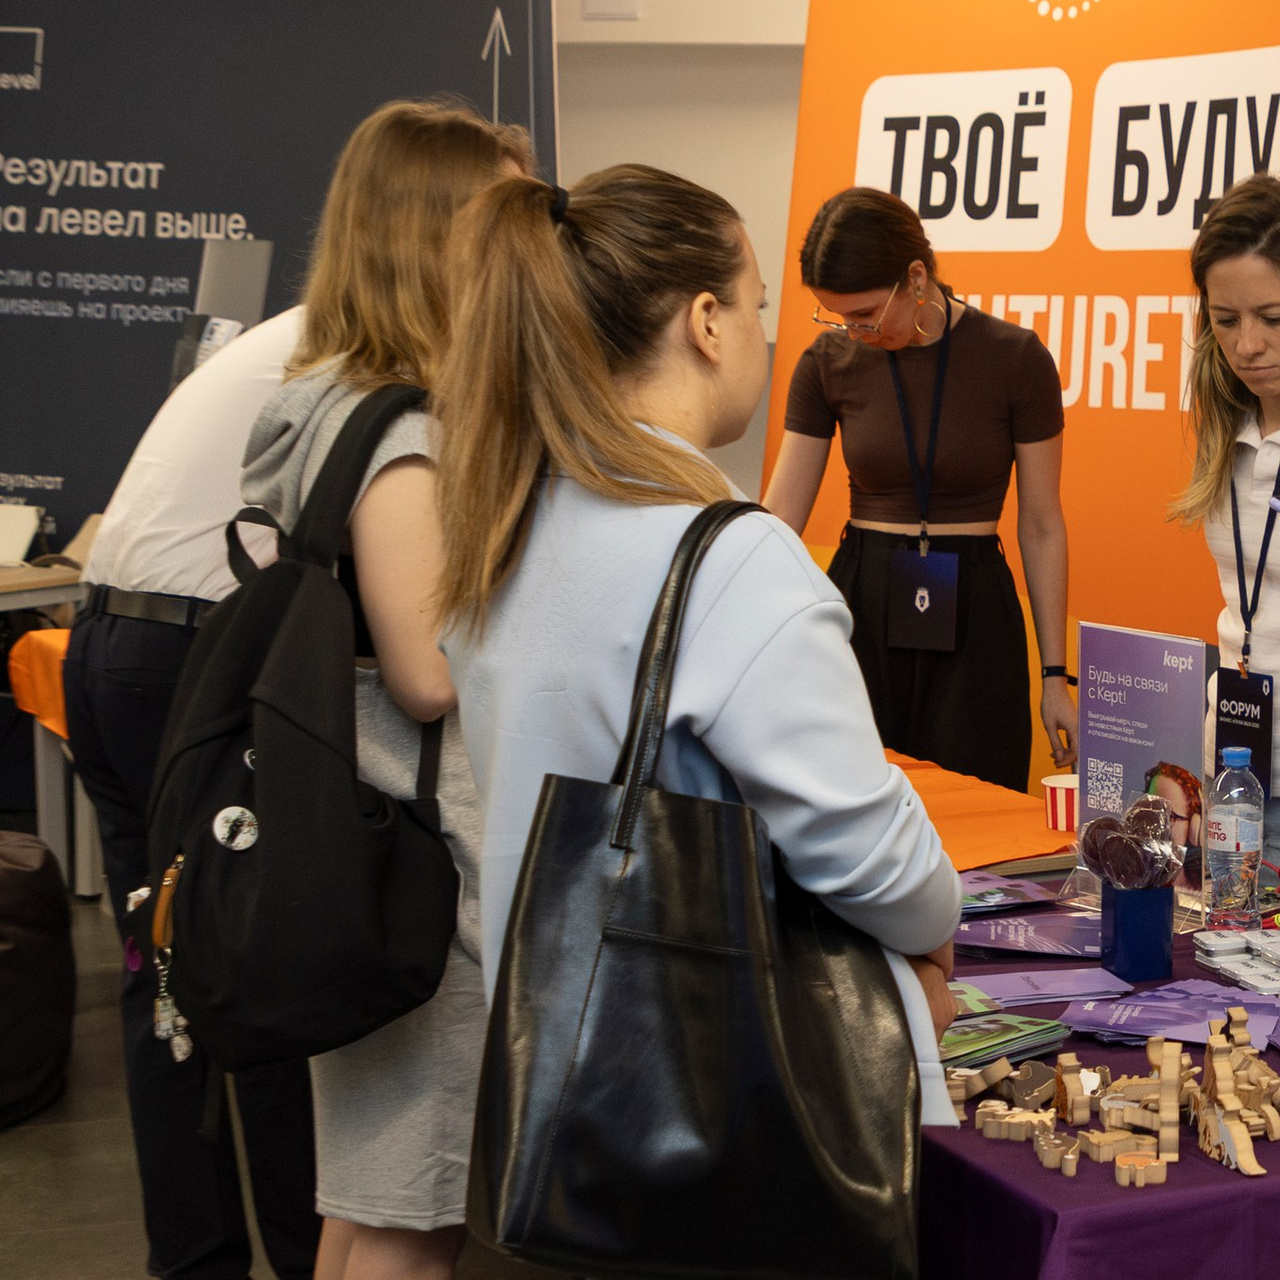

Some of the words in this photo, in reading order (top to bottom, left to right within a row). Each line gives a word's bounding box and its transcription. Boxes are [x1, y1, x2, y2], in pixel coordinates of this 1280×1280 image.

[883, 91, 1047, 220] ТВОЁ
[36, 207, 146, 237] левел
[155, 212, 254, 240] выше.
[37, 271, 52, 288] с
[57, 272, 146, 297] первого
[149, 276, 189, 297] дня
[78, 302, 107, 320] на
[1163, 650, 1194, 673] kept
[1088, 665, 1116, 685] Будь
[1118, 674, 1132, 687] на
[1134, 676, 1169, 694] связи
[1088, 687, 1096, 699] с
[1097, 686, 1127, 707] Kept!
[1220, 698, 1260, 720] ФОРУМ
